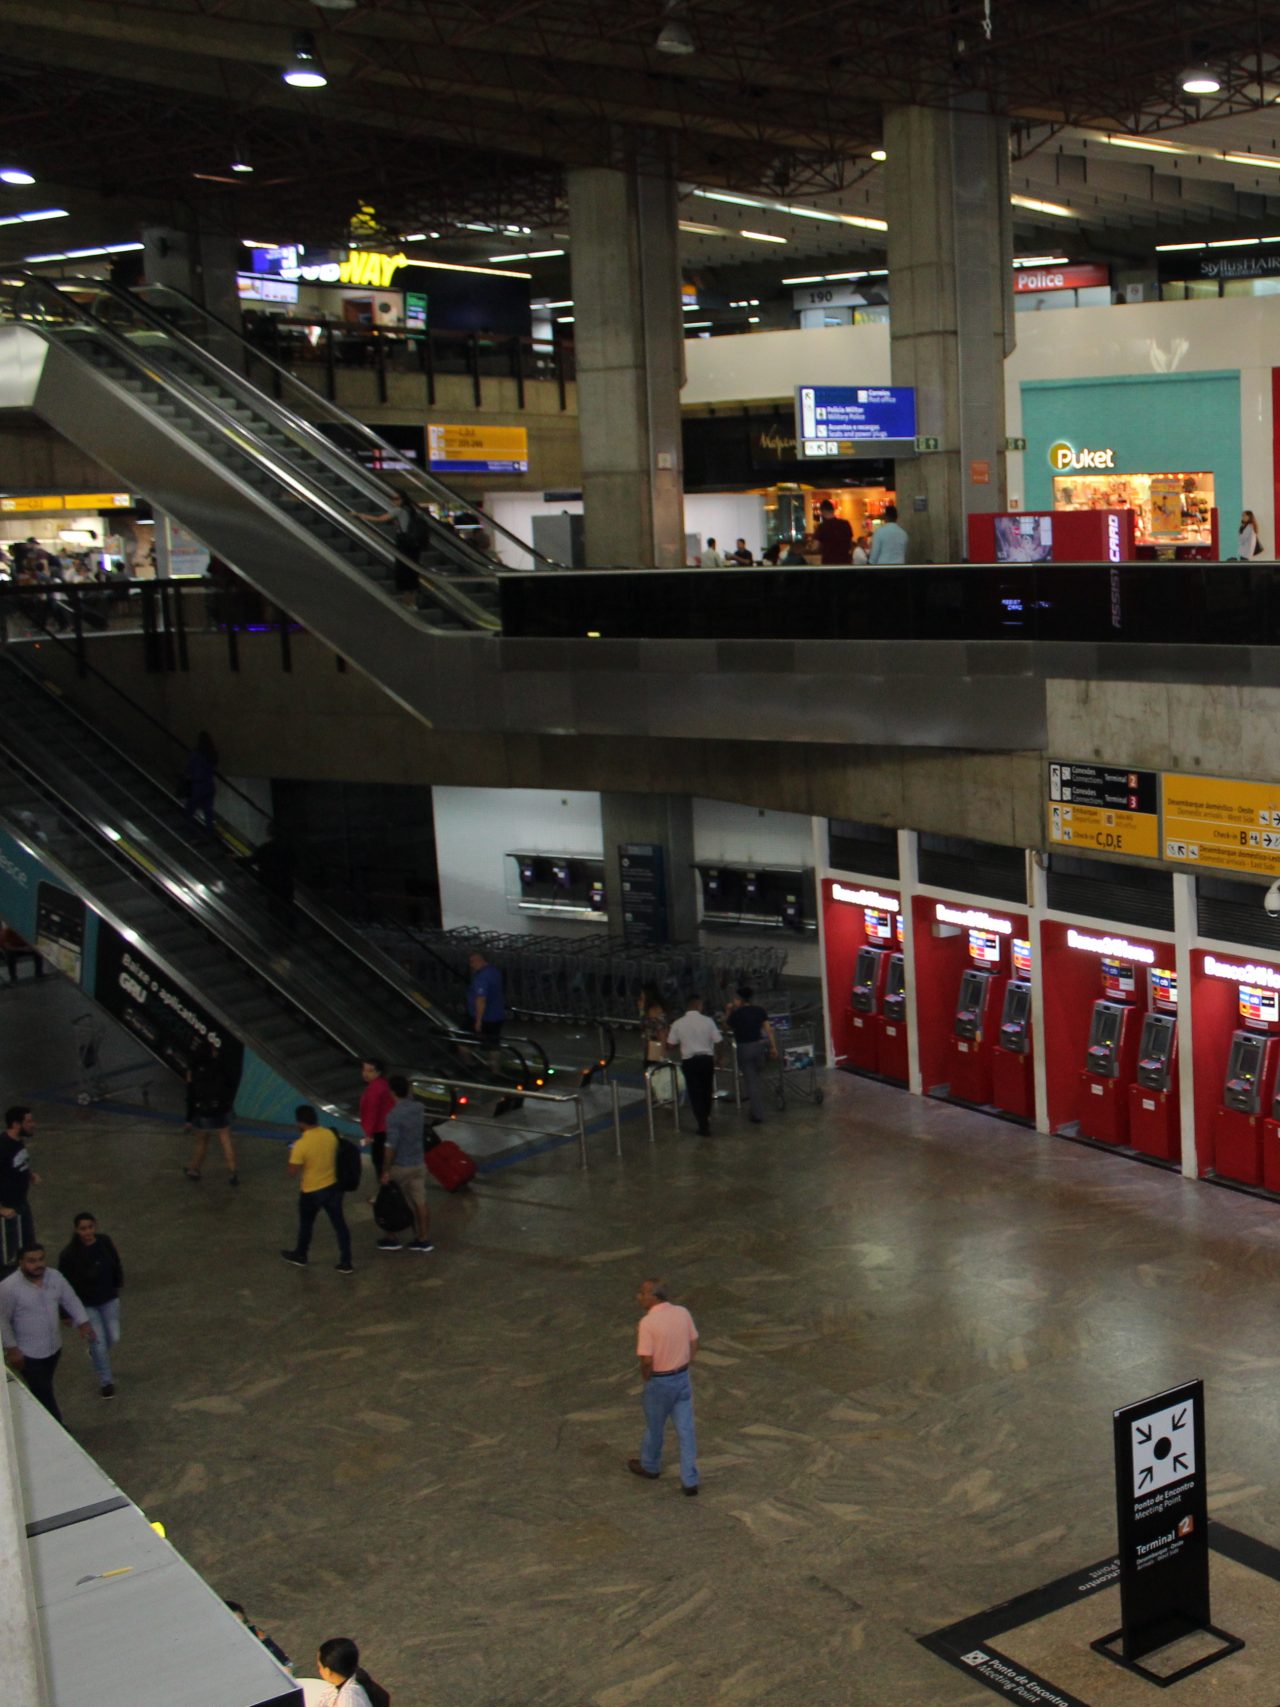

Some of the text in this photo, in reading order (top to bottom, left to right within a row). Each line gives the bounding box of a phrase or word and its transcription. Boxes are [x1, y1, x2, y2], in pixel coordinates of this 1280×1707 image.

[1018, 271, 1065, 289] Police
[809, 290, 833, 304] 190
[1057, 448, 1114, 469] Puket
[1108, 514, 1120, 563] CARD
[1240, 831, 1247, 845] B
[119, 972, 147, 1004] GRU
[1134, 1481, 1195, 1512] Ponto de Encontro
[1135, 1495, 1181, 1520] Meeting Point
[1136, 1529, 1175, 1555] Terminal
[977, 1664, 1041, 1704] Meeting Point
[989, 1659, 1069, 1707] Ponto de Encontro
